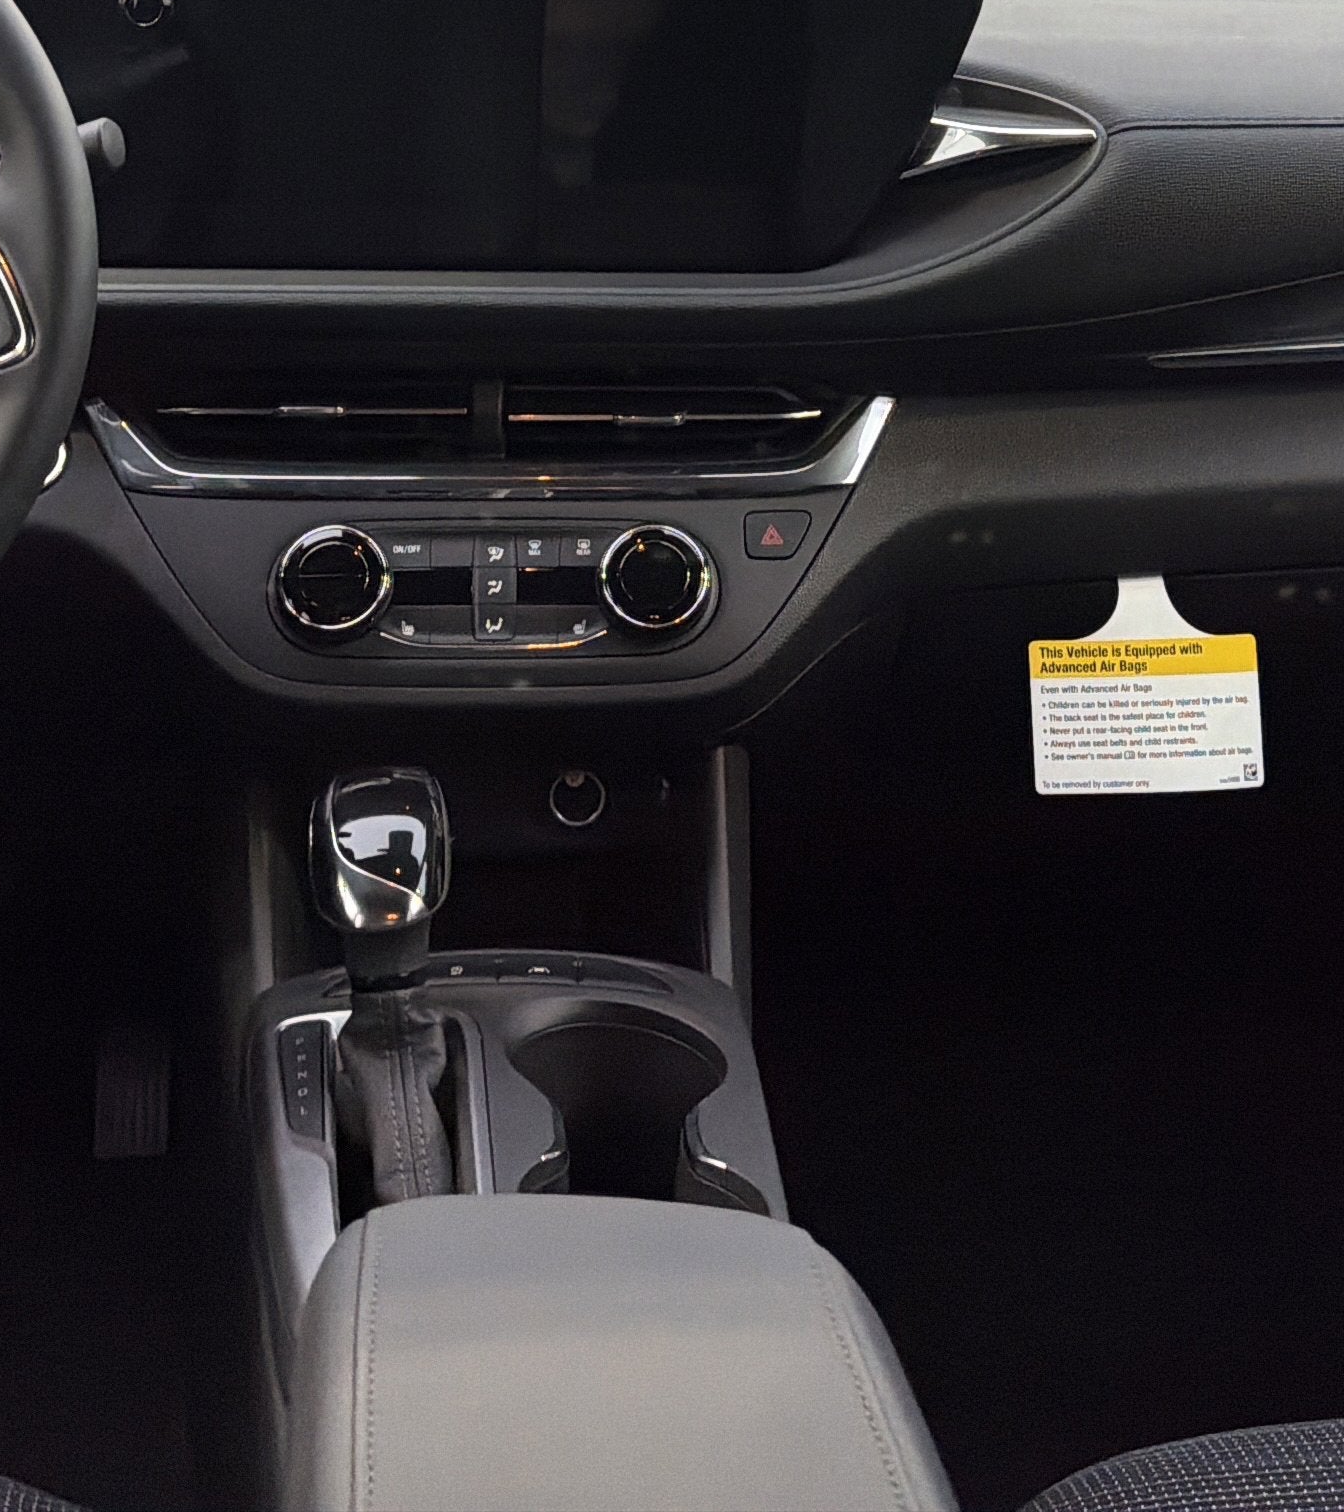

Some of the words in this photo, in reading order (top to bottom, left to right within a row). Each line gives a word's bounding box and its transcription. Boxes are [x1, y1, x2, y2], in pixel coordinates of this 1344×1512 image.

[393, 545, 421, 554] ON/OFF
[1040, 647, 1063, 658] This
[1067, 645, 1108, 658] Vehicle
[1112, 645, 1121, 656] is
[1125, 643, 1176, 658] Equipped
[1179, 643, 1202, 654] with
[1040, 660, 1096, 673] Advanced
[1101, 660, 1115, 672] Air
[1120, 660, 1148, 672] Bags
[1041, 686, 1059, 694] Even
[1062, 685, 1078, 693] with
[1081, 685, 1118, 693] Advanced
[1133, 684, 1152, 692] Bags
[1048, 701, 1079, 709] Children
[1109, 700, 1128, 708] killed
[1141, 699, 1173, 708] seriously
[1175, 698, 1200, 707] injured
[1202, 698, 1210, 706] by
[1225, 696, 1233, 704] air
[1146, 712, 1164, 721] place
[1050, 727, 1070, 735] Never
[1073, 727, 1084, 735] put
[1093, 726, 1132, 735] rear-facing
[1134, 725, 1151, 733] child
[1051, 740, 1076, 748] Always
[1067, 752, 1094, 760] owner's
[1137, 751, 1147, 759] for
[1169, 749, 1206, 757] information
[1062, 781, 1091, 789] removed
[1093, 781, 1100, 789] by
[1103, 780, 1133, 788] customer
